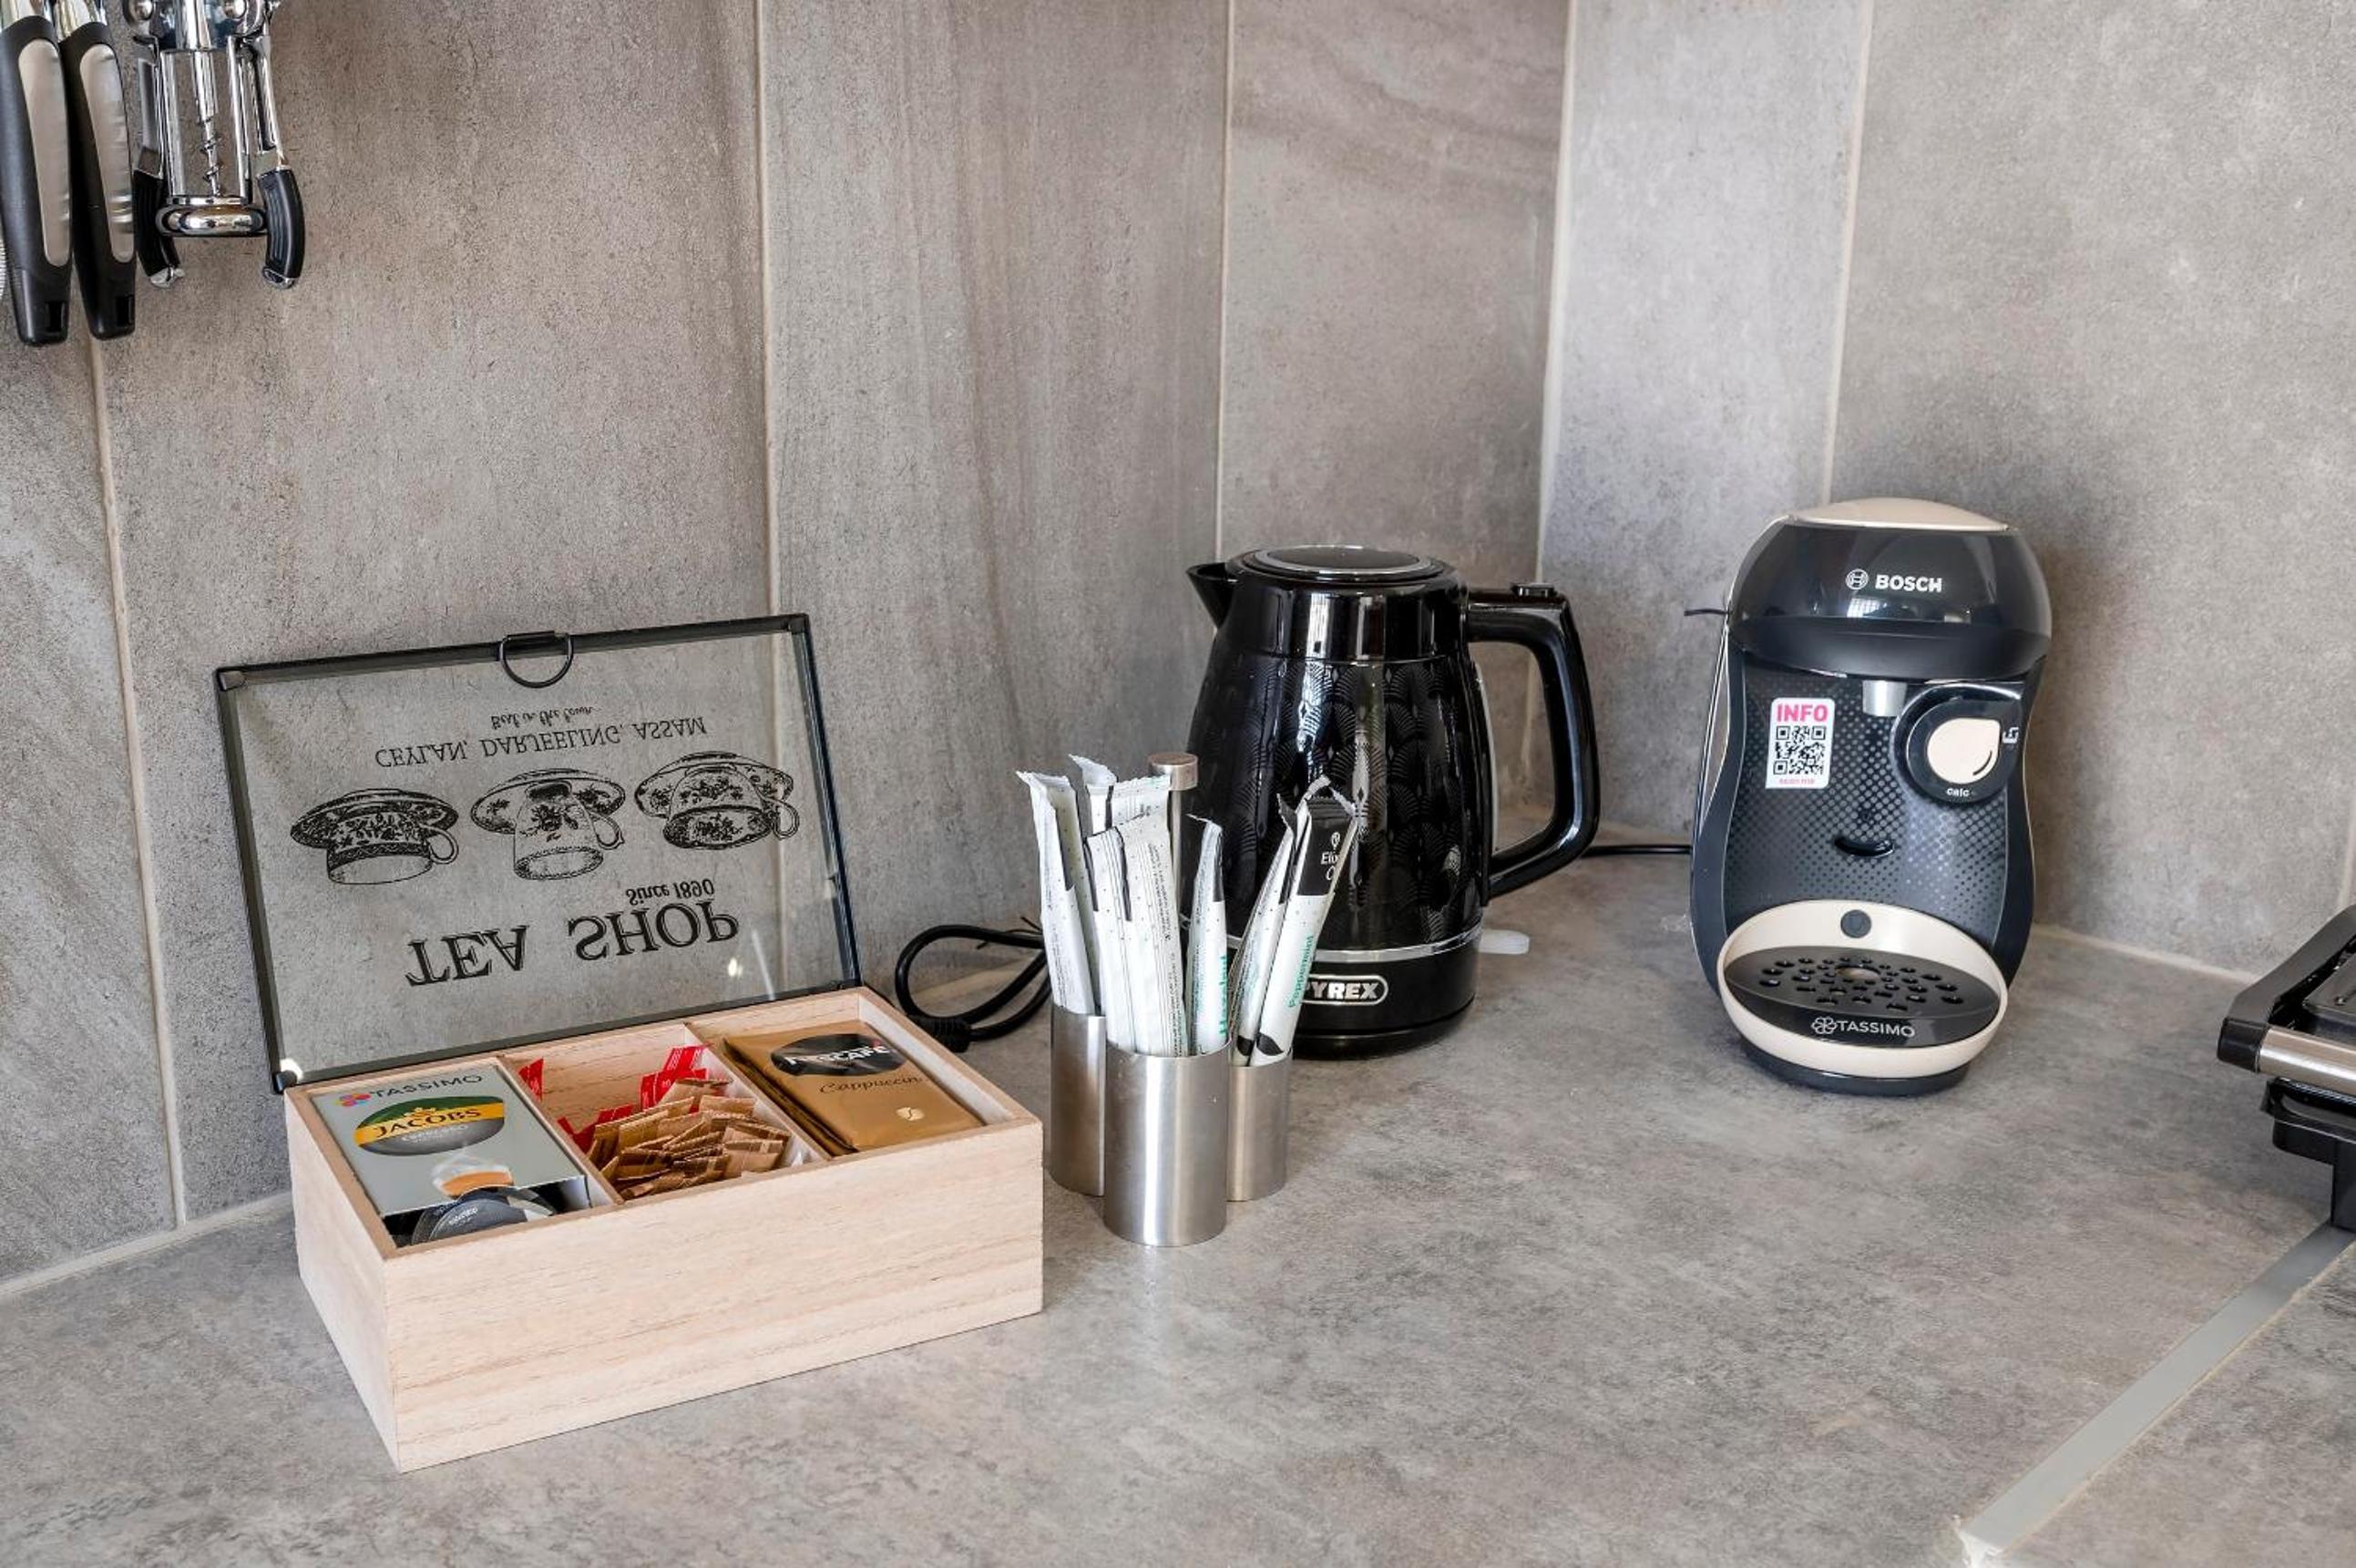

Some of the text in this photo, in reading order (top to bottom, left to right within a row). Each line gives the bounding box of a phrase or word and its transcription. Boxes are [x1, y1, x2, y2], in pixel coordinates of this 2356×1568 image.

[1875, 574, 1942, 592] BOSCH
[1777, 703, 1829, 723] INFO
[1306, 981, 1379, 999] YREX
[1837, 1020, 1915, 1038] TASSIMO
[371, 1073, 483, 1099] TASSIMO
[374, 1109, 481, 1138] JACOBS
